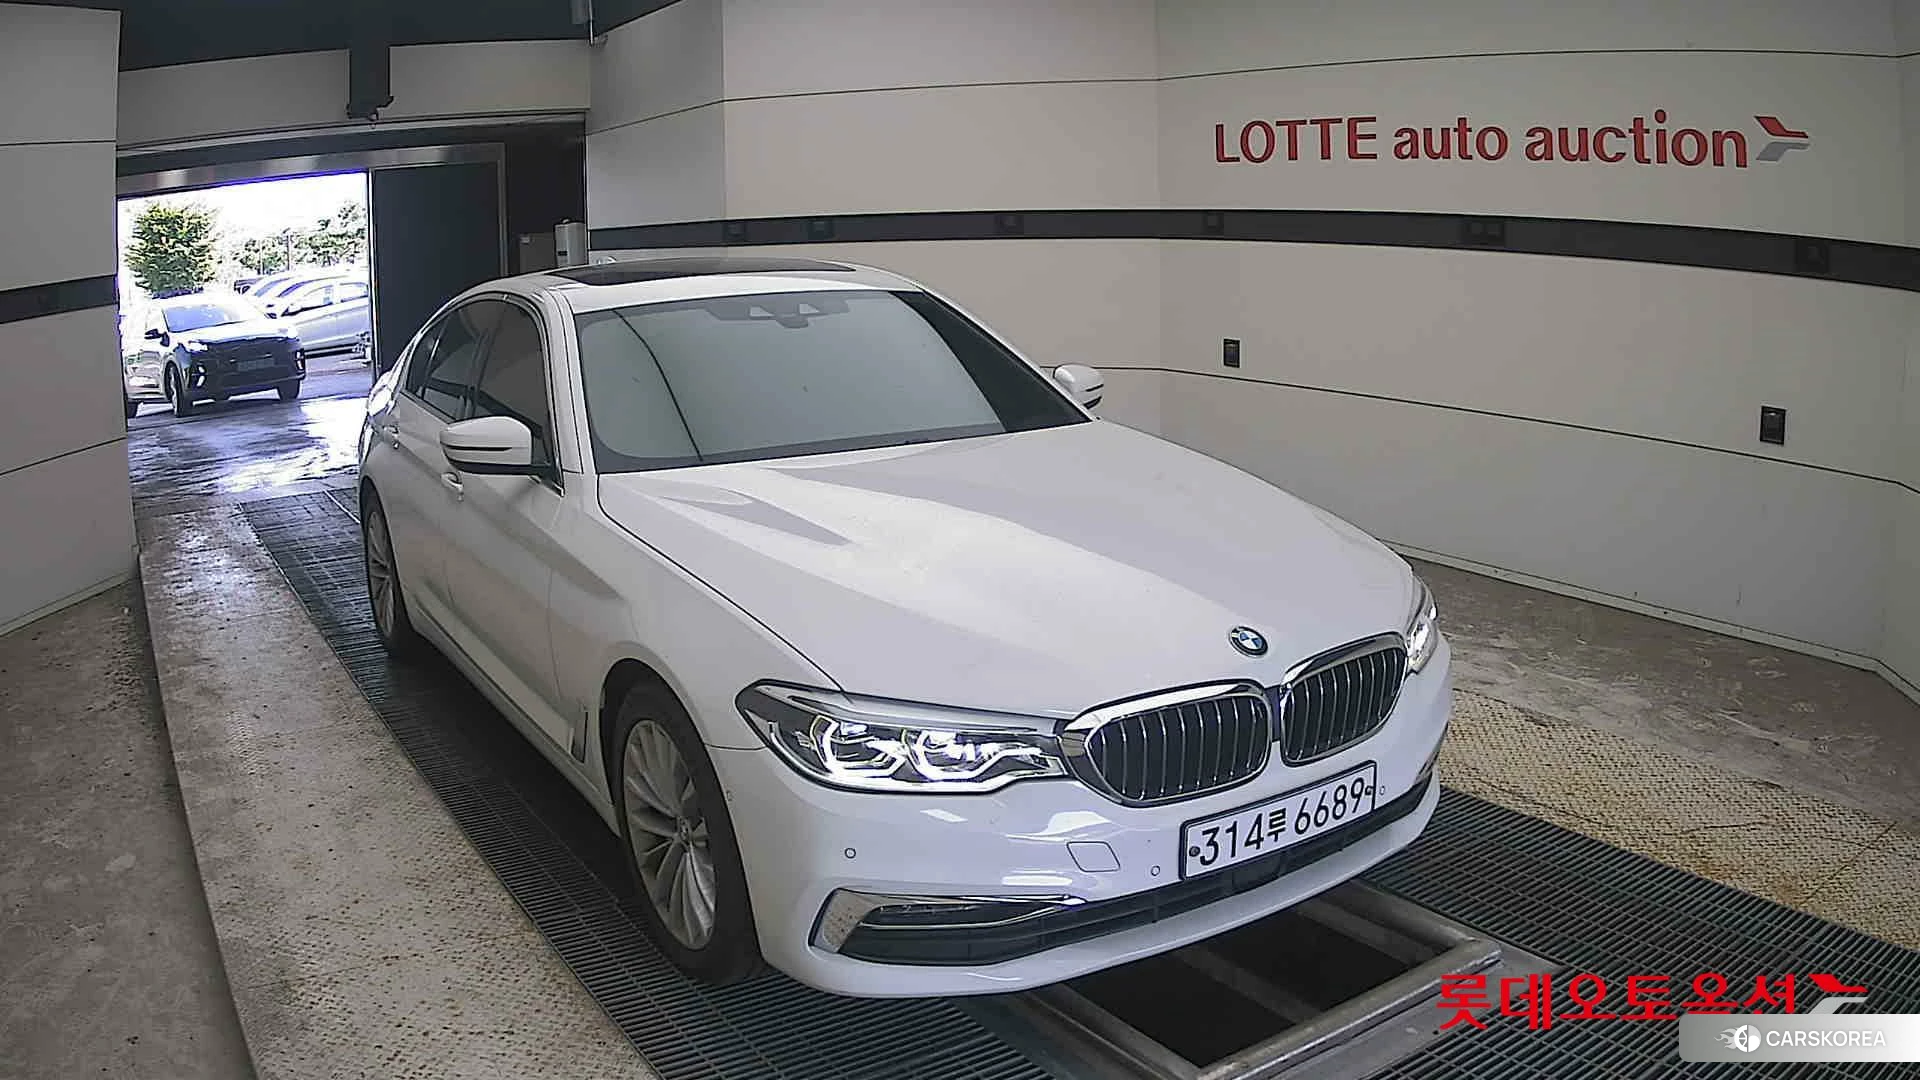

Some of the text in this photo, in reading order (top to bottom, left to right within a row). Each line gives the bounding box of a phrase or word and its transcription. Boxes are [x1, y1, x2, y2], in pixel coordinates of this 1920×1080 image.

[1215, 109, 1748, 168] LOTTE auto auction
[1199, 777, 1365, 866] 314루 6689
